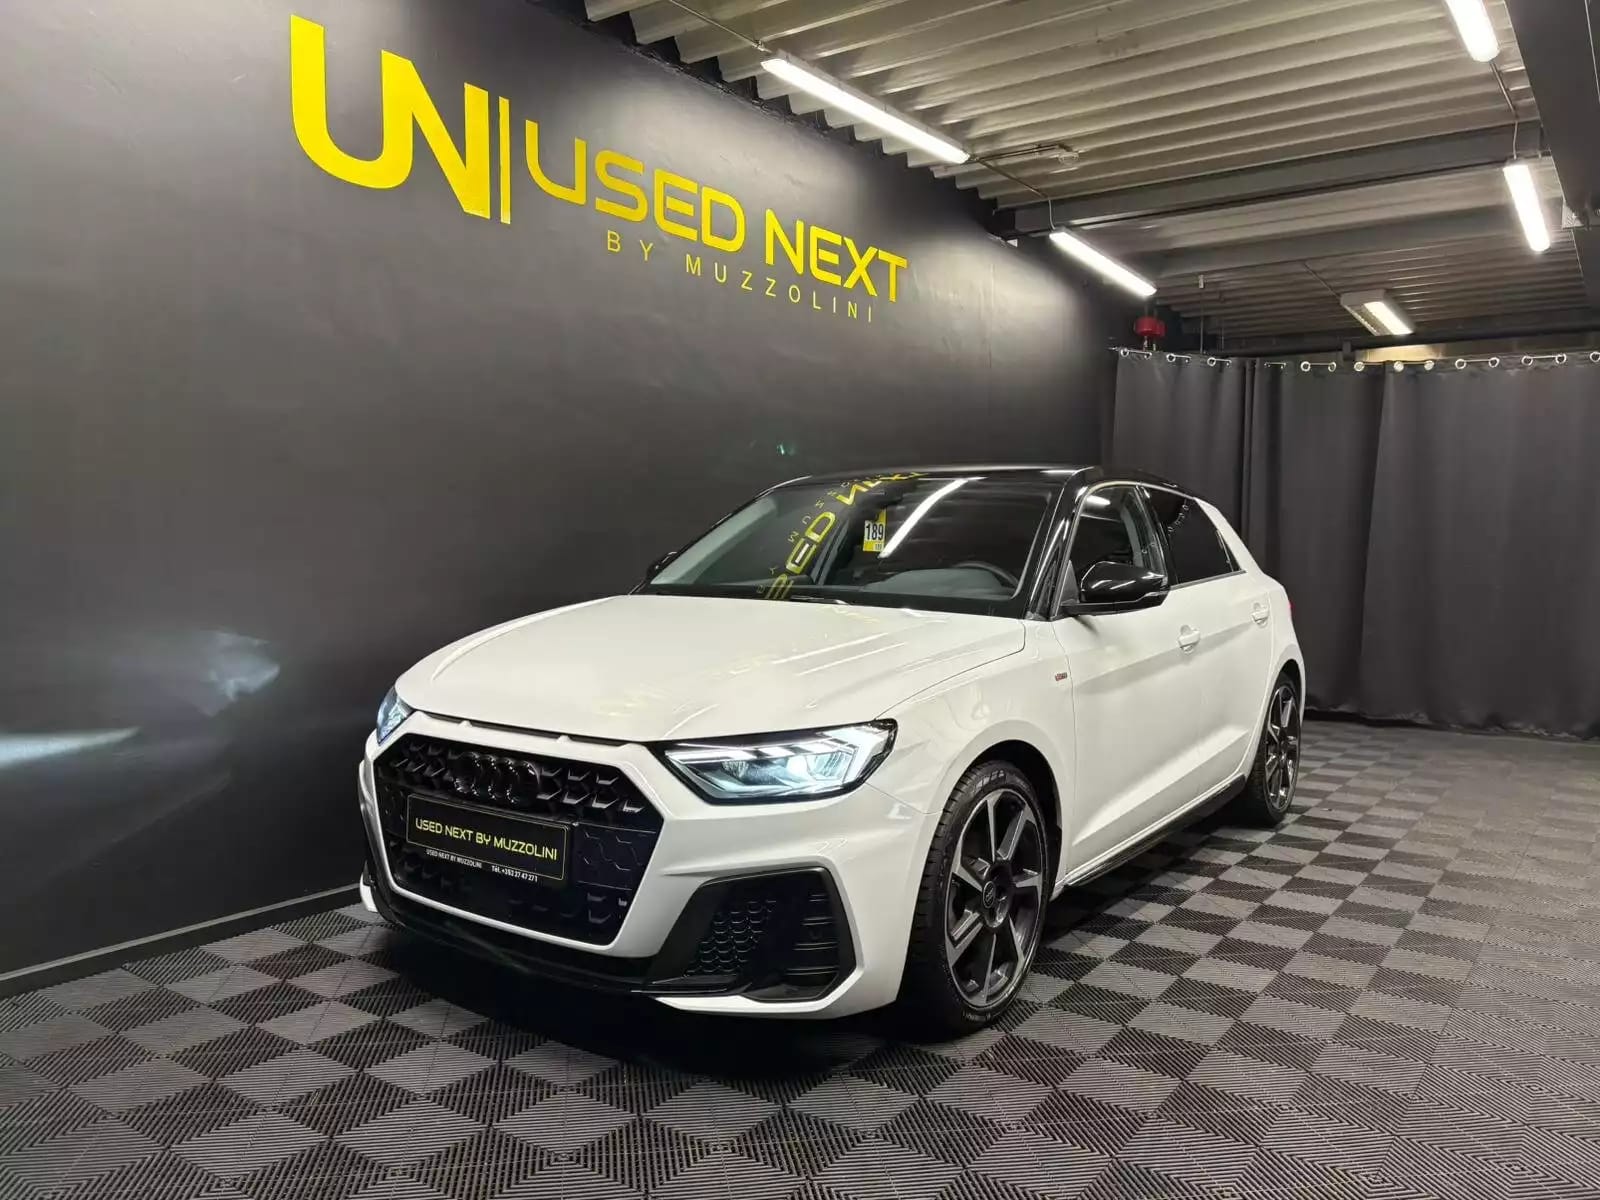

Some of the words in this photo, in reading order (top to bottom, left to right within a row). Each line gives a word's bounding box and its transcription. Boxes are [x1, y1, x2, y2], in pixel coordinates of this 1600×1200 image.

[525, 119, 746, 253] USED
[765, 208, 908, 303] NEXT
[607, 229, 655, 261] BY
[685, 255, 873, 322] MUZZOLINI
[866, 523, 884, 541] 189
[415, 817, 443, 834] USED
[445, 825, 474, 842] NEXT
[475, 832, 492, 846] BY
[493, 836, 558, 861] MUZZOLINI
[457, 856, 482, 869] MUZZOLINI
